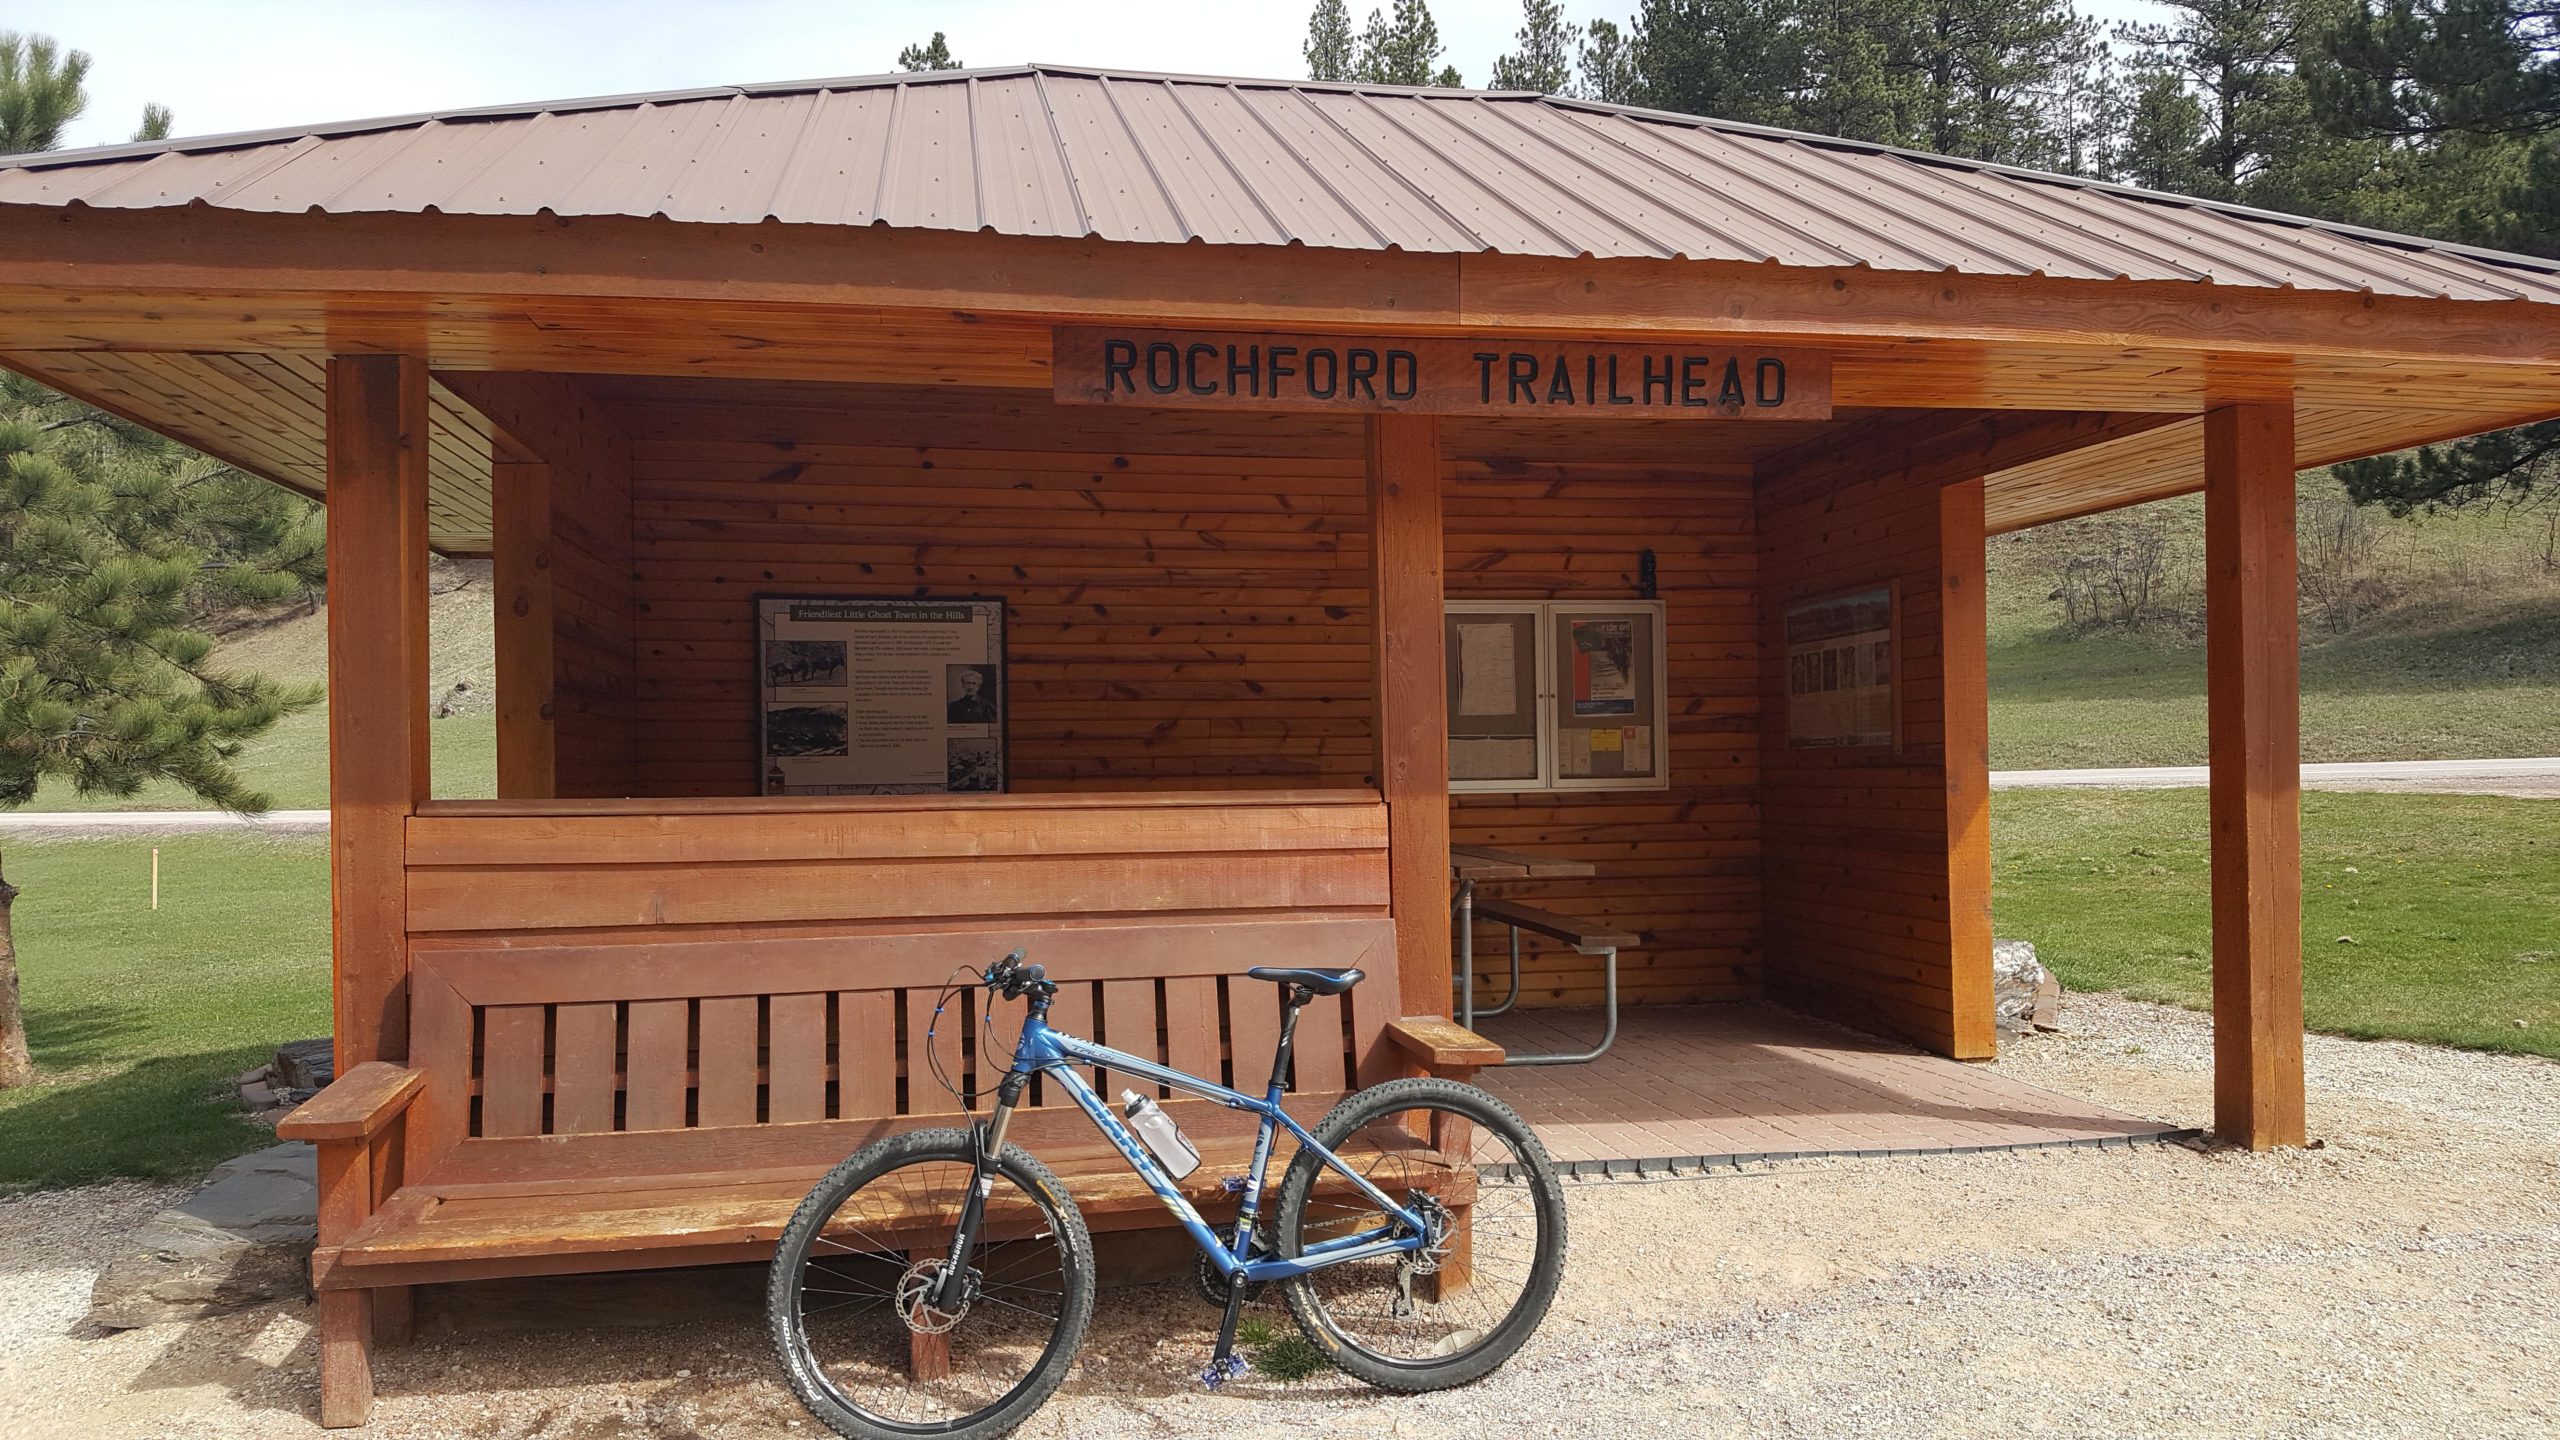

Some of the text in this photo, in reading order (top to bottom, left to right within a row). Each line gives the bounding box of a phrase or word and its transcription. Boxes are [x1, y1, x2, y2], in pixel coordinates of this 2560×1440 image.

[1104, 338, 1787, 408] ROCHFORD TRAILHEAD
[798, 608, 965, 620] Friendliest Little Ghost Town in the Hills
[1072, 1044, 1115, 1062] TALON
[1081, 1088, 1160, 1172] GIANT
[781, 1316, 823, 1402] PROTECTION
